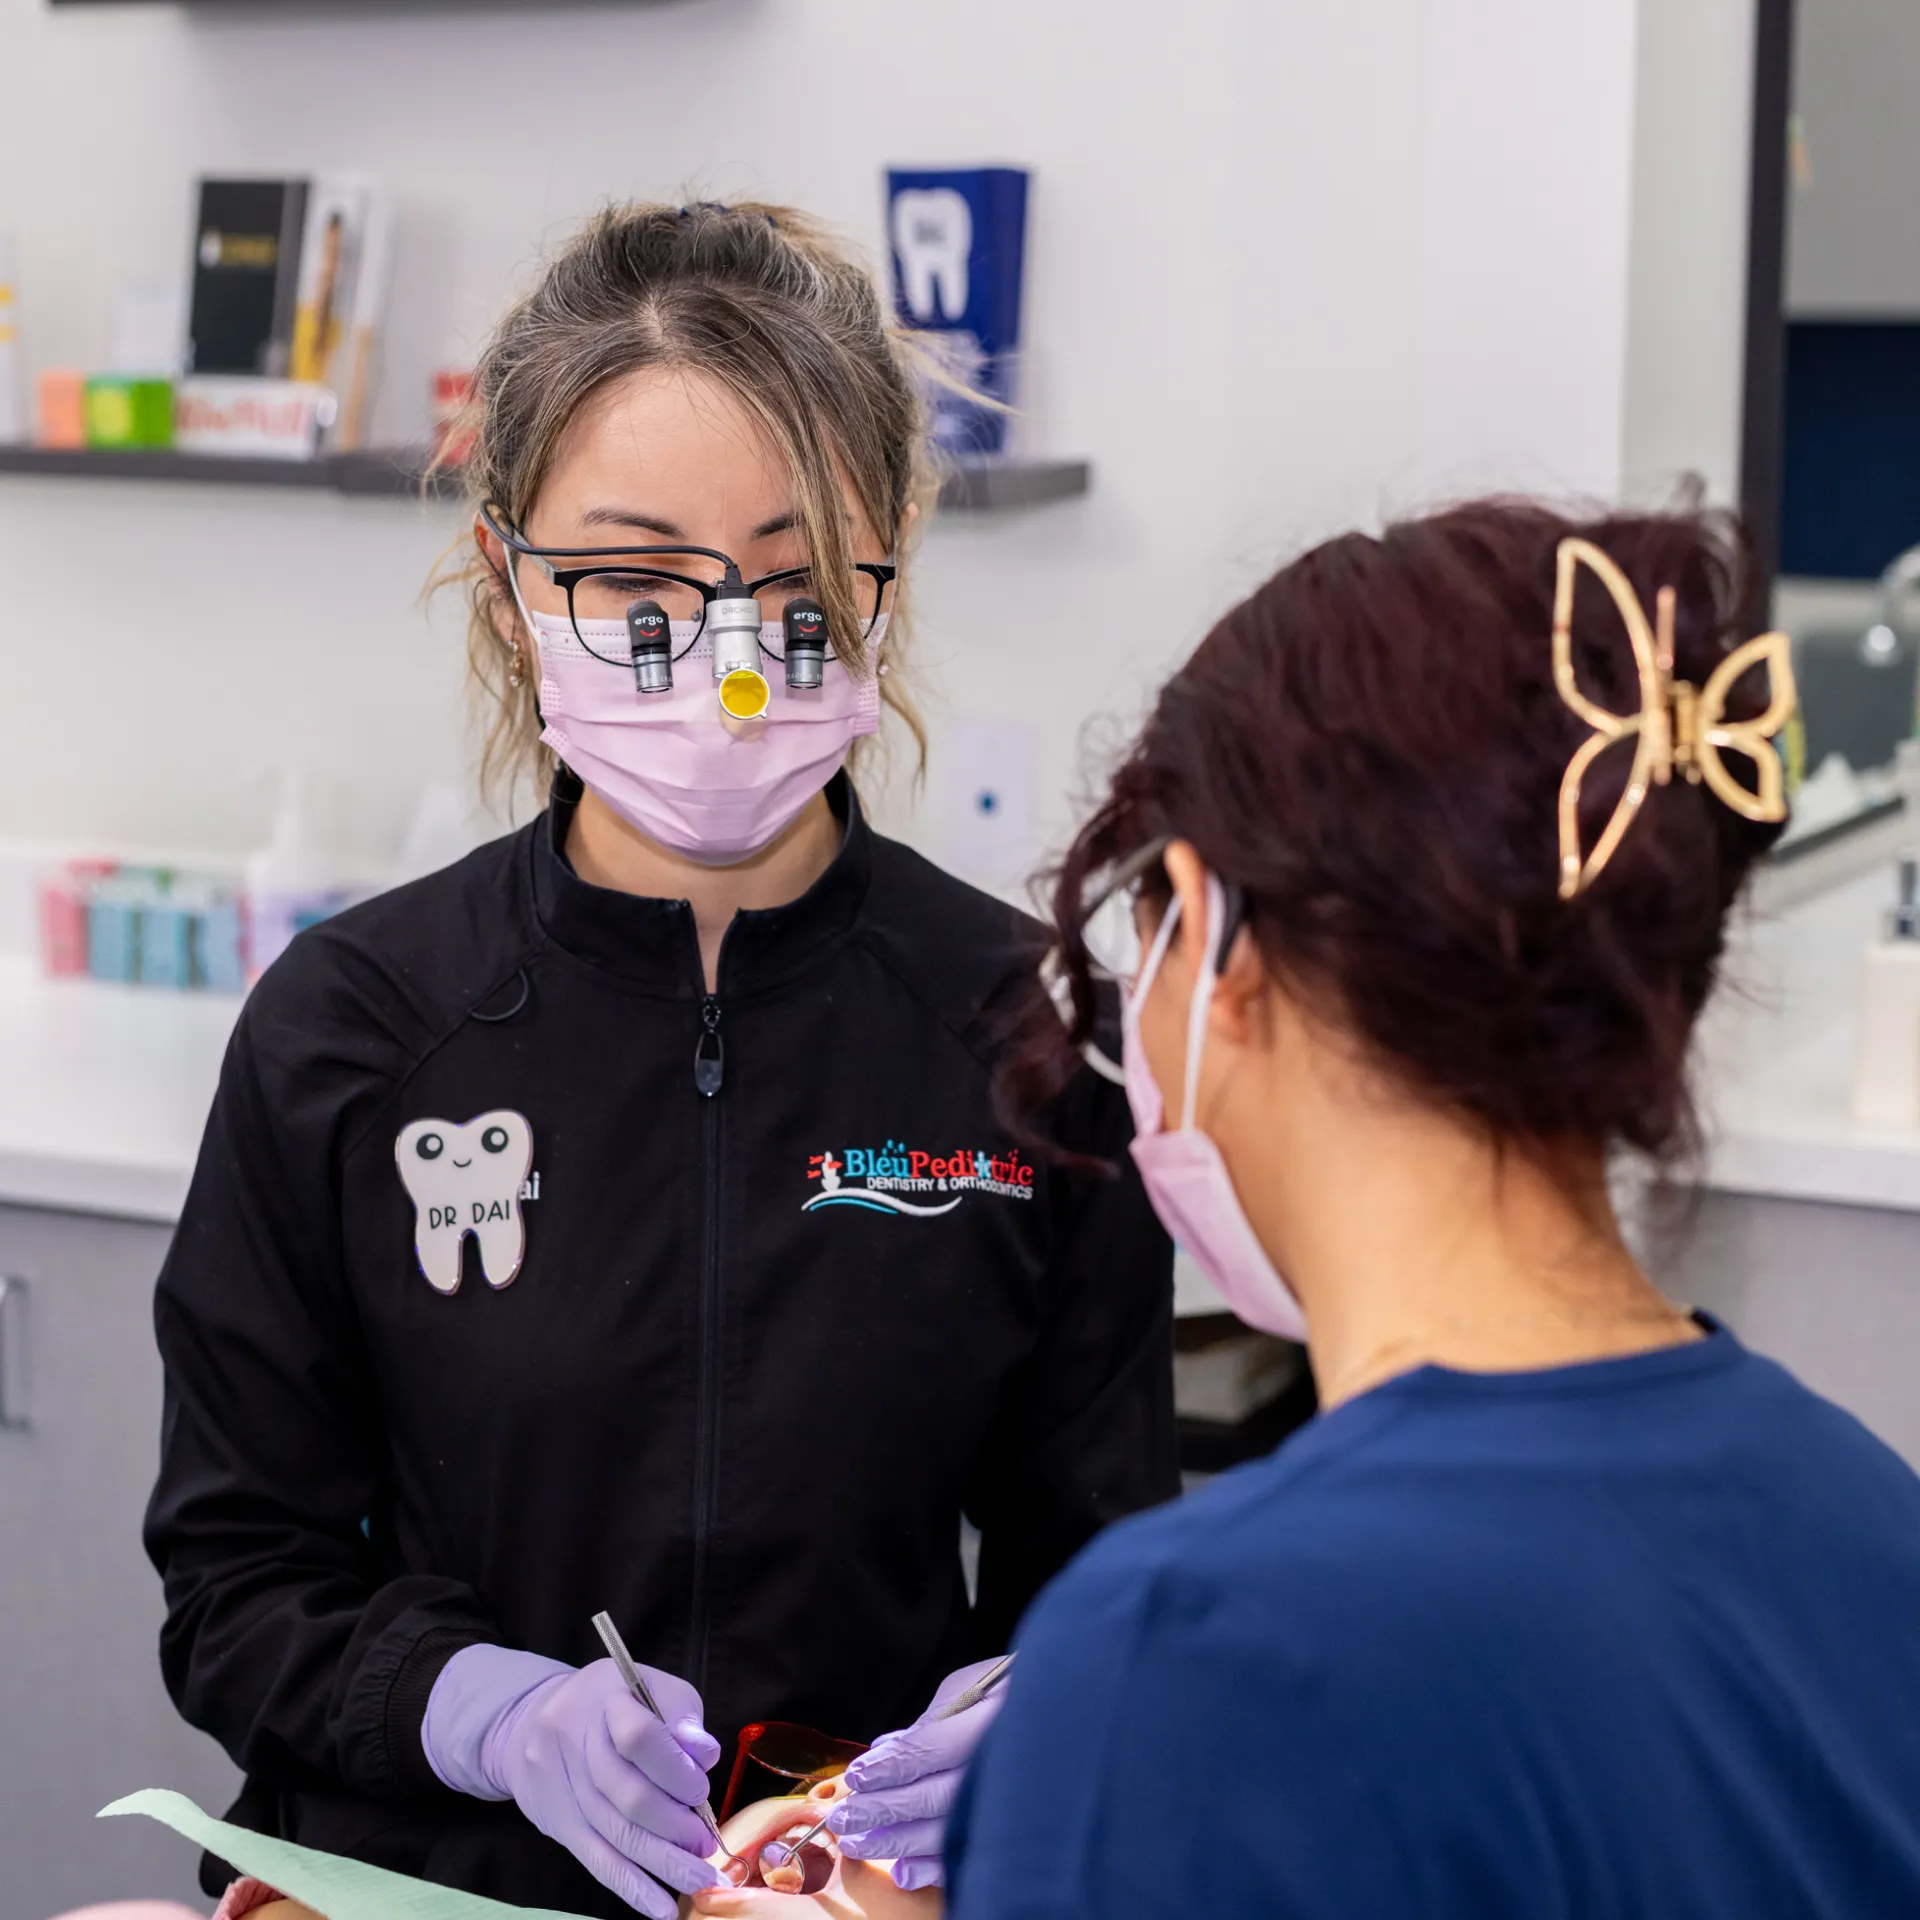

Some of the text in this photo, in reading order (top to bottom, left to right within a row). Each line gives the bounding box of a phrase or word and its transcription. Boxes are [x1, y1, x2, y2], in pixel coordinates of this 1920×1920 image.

[634, 615, 664, 626] ergo
[793, 611, 823, 622] ergo
[866, 1177, 934, 1192] DENTISTRY
[937, 1178, 947, 1191] &
[429, 1199, 510, 1229] DR DAI
